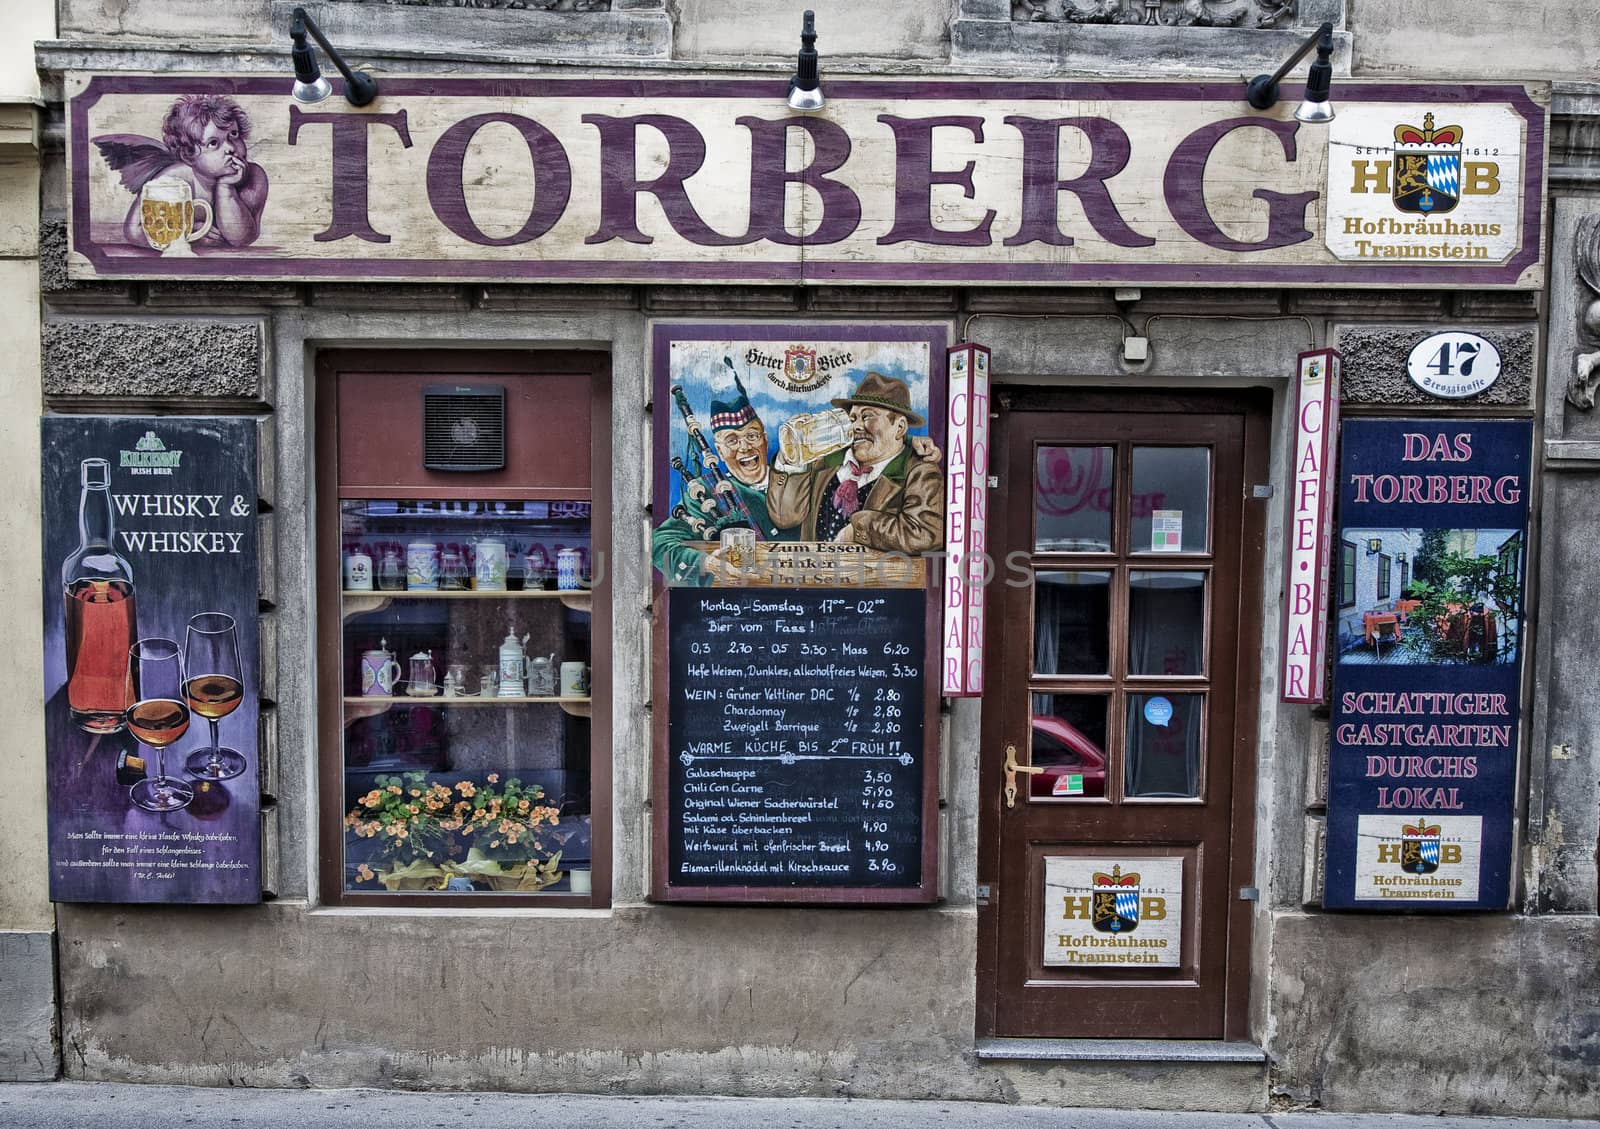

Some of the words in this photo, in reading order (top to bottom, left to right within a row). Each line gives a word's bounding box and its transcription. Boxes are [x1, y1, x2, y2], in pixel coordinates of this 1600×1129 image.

[1356, 147, 1389, 155] SEIT
[1465, 148, 1499, 156] 1612
[288, 104, 1320, 252] TORBERG
[1342, 217, 1501, 236] Hofbräuhaus
[1355, 241, 1488, 258] Traunstein
[745, 348, 784, 370] Hirter
[817, 352, 853, 371] Biere
[1426, 342, 1481, 377] 47
[1402, 433, 1472, 462] DAS
[120, 450, 183, 467] KILKENNY
[131, 467, 152, 475] IRISH
[153, 467, 173, 475] BEER
[1351, 474, 1520, 504] TORBERG
[112, 494, 223, 518] WHISKY
[230, 494, 250, 517] &
[120, 531, 244, 554] WHISKEY
[768, 542, 810, 553] Zum
[816, 542, 866, 553] Essen
[967, 393, 988, 692] TORBERG
[708, 620, 733, 633] Bier
[740, 624, 763, 633] vom
[691, 642, 711, 655] 0,3
[727, 641, 753, 654] 2,70
[800, 643, 827, 656] 3,30
[842, 642, 868, 655] Mass
[883, 641, 910, 655] 6,20
[892, 663, 918, 678] 3,30
[726, 687, 762, 700] Grüner
[764, 688, 805, 700] Veltliner
[810, 688, 835, 701] DAC
[874, 688, 901, 702] 2,80
[1342, 692, 1509, 715] SCHATTIGER
[724, 704, 786, 720] Chardonnay
[873, 705, 901, 719] 2,80
[775, 720, 820, 739] Barrique
[871, 721, 901, 735] 2,80
[1336, 724, 1512, 747] GASTGARTEN
[688, 741, 733, 754] WARME
[745, 738, 787, 753] KÜCHE
[798, 741, 818, 752] BIS
[1365, 755, 1478, 778] DURCHS
[686, 767, 757, 781] Gulaschsuppe
[863, 770, 892, 784] 3,50
[683, 782, 707, 793] Chili
[709, 782, 729, 792] Con
[731, 782, 764, 793] Carne
[684, 797, 725, 810] Original
[727, 798, 761, 808] Wiener
[763, 797, 839, 809] Sacherwürstel
[1377, 787, 1464, 810] LOKAL
[683, 811, 719, 823] Salami
[684, 825, 699, 834] mit
[703, 824, 728, 834] Käse
[731, 824, 793, 834] überbacken
[743, 840, 759, 852] mit
[865, 839, 889, 852] 4,90
[770, 861, 783, 872] mit
[788, 860, 849, 872] Kirschsauce
[1373, 875, 1462, 886] Hofbräuhaus
[1380, 888, 1455, 899] Traunstein
[1058, 935, 1167, 948] Hofbräuhaus
[1066, 950, 1160, 964] Traunstein
